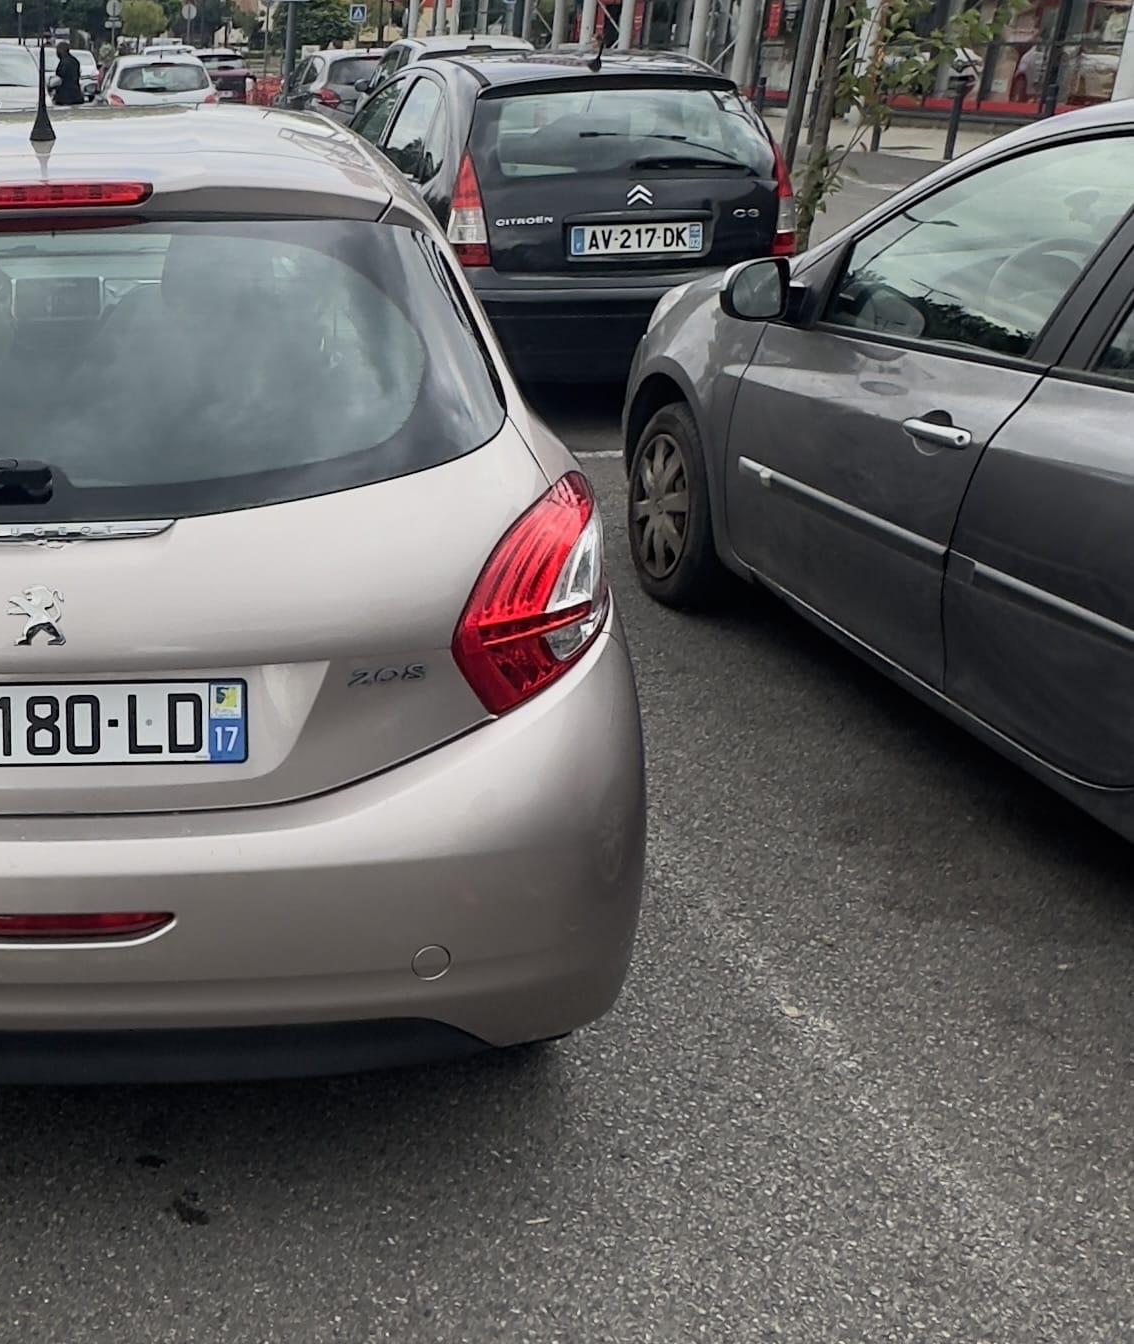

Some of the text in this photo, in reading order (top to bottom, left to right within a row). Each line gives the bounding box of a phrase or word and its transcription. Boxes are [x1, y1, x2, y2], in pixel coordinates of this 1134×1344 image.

[732, 208, 759, 218] C3
[587, 226, 687, 251] AV-217-DK
[347, 663, 426, 687] 208
[214, 726, 239, 752] 17
